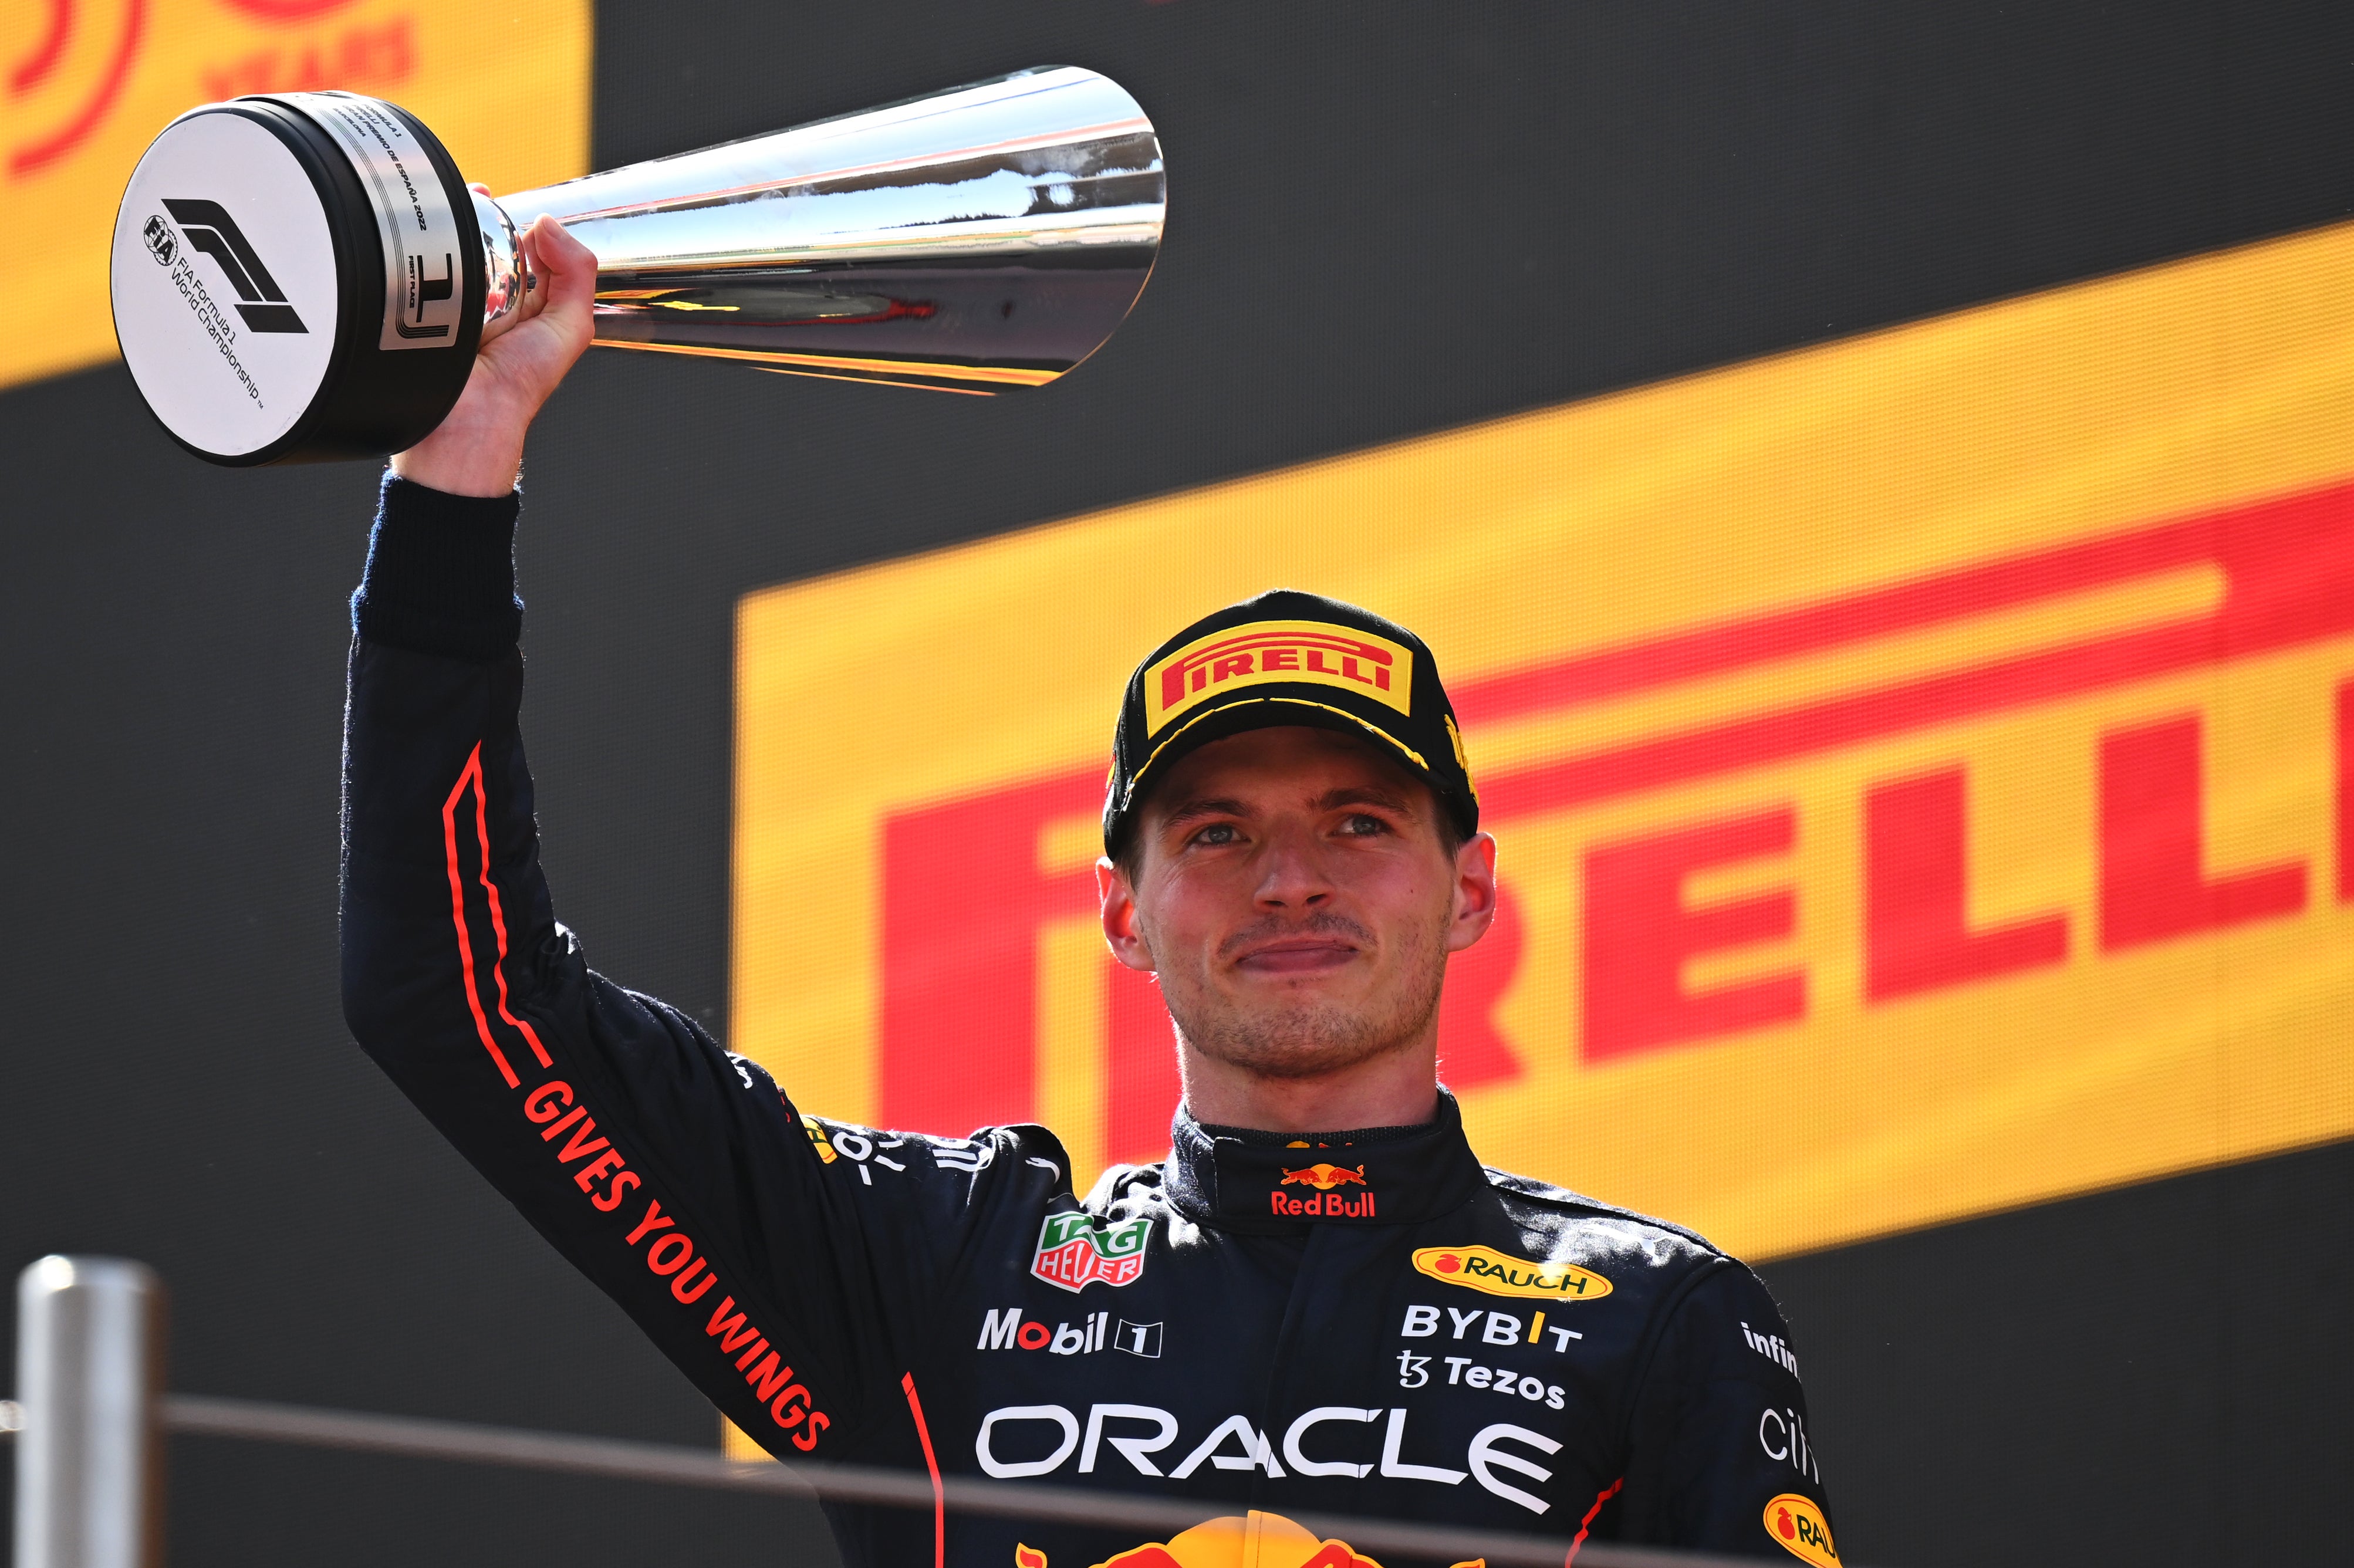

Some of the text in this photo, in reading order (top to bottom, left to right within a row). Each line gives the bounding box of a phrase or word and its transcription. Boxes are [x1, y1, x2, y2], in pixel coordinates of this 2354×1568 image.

[362, 121, 390, 149] PREMIO
[387, 150, 400, 163] DE
[395, 163, 418, 204] ESPAÑA
[414, 204, 427, 232] 2022
[177, 256, 236, 346] FIA Formula 1
[171, 267, 200, 311] World
[197, 307, 259, 399] Championship
[1161, 631, 1393, 711] PIRELLI
[1271, 1191, 1375, 1218] Red Bull
[1040, 1242, 1138, 1284] HEUER
[1053, 1216, 1139, 1255] TAG
[524, 1082, 830, 1451] GIVES YOU WINGS
[1464, 1256, 1588, 1295] RAUCH
[977, 1307, 1148, 1356] Mobil 1
[1400, 1305, 1583, 1353] BYBIT
[1741, 1322, 1801, 1384] infin
[1444, 1356, 1566, 1410] Tezos
[975, 1403, 1565, 1515] ORACLE
